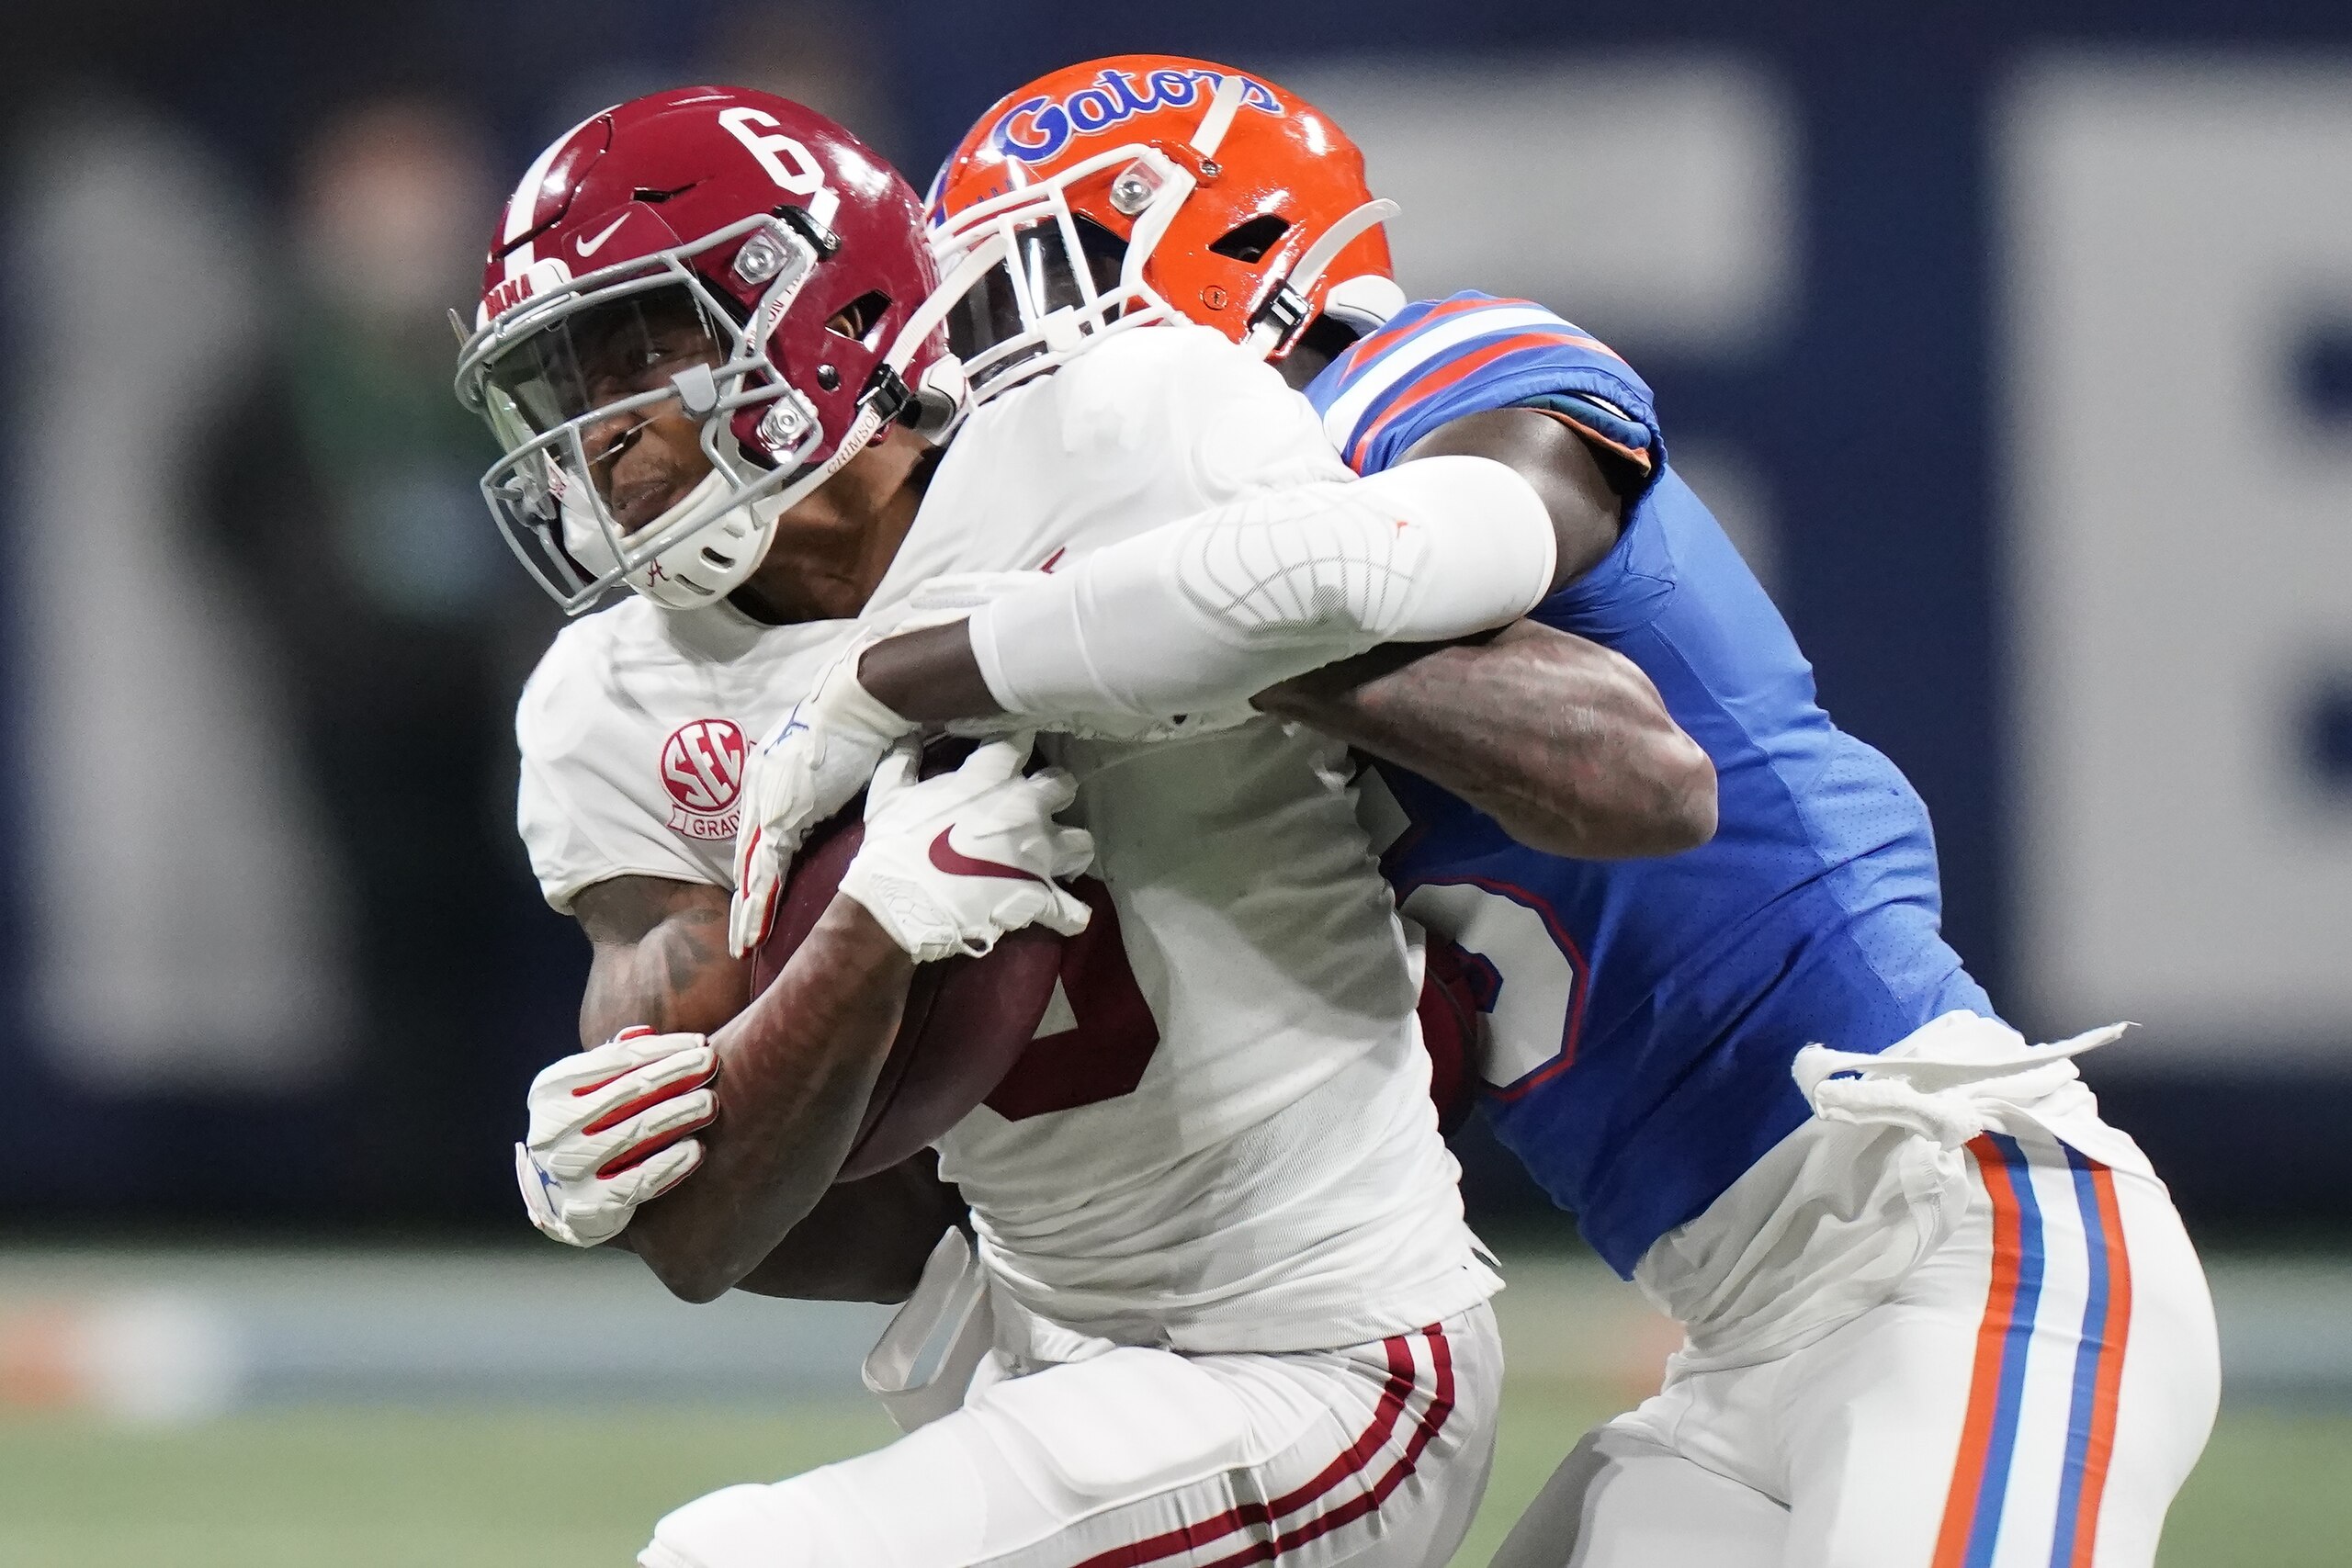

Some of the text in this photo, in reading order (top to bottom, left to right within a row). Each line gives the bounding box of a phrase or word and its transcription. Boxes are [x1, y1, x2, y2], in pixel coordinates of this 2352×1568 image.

[718, 107, 825, 196] 6
[663, 721, 741, 807] SEC
[691, 809, 741, 837] GRAD
